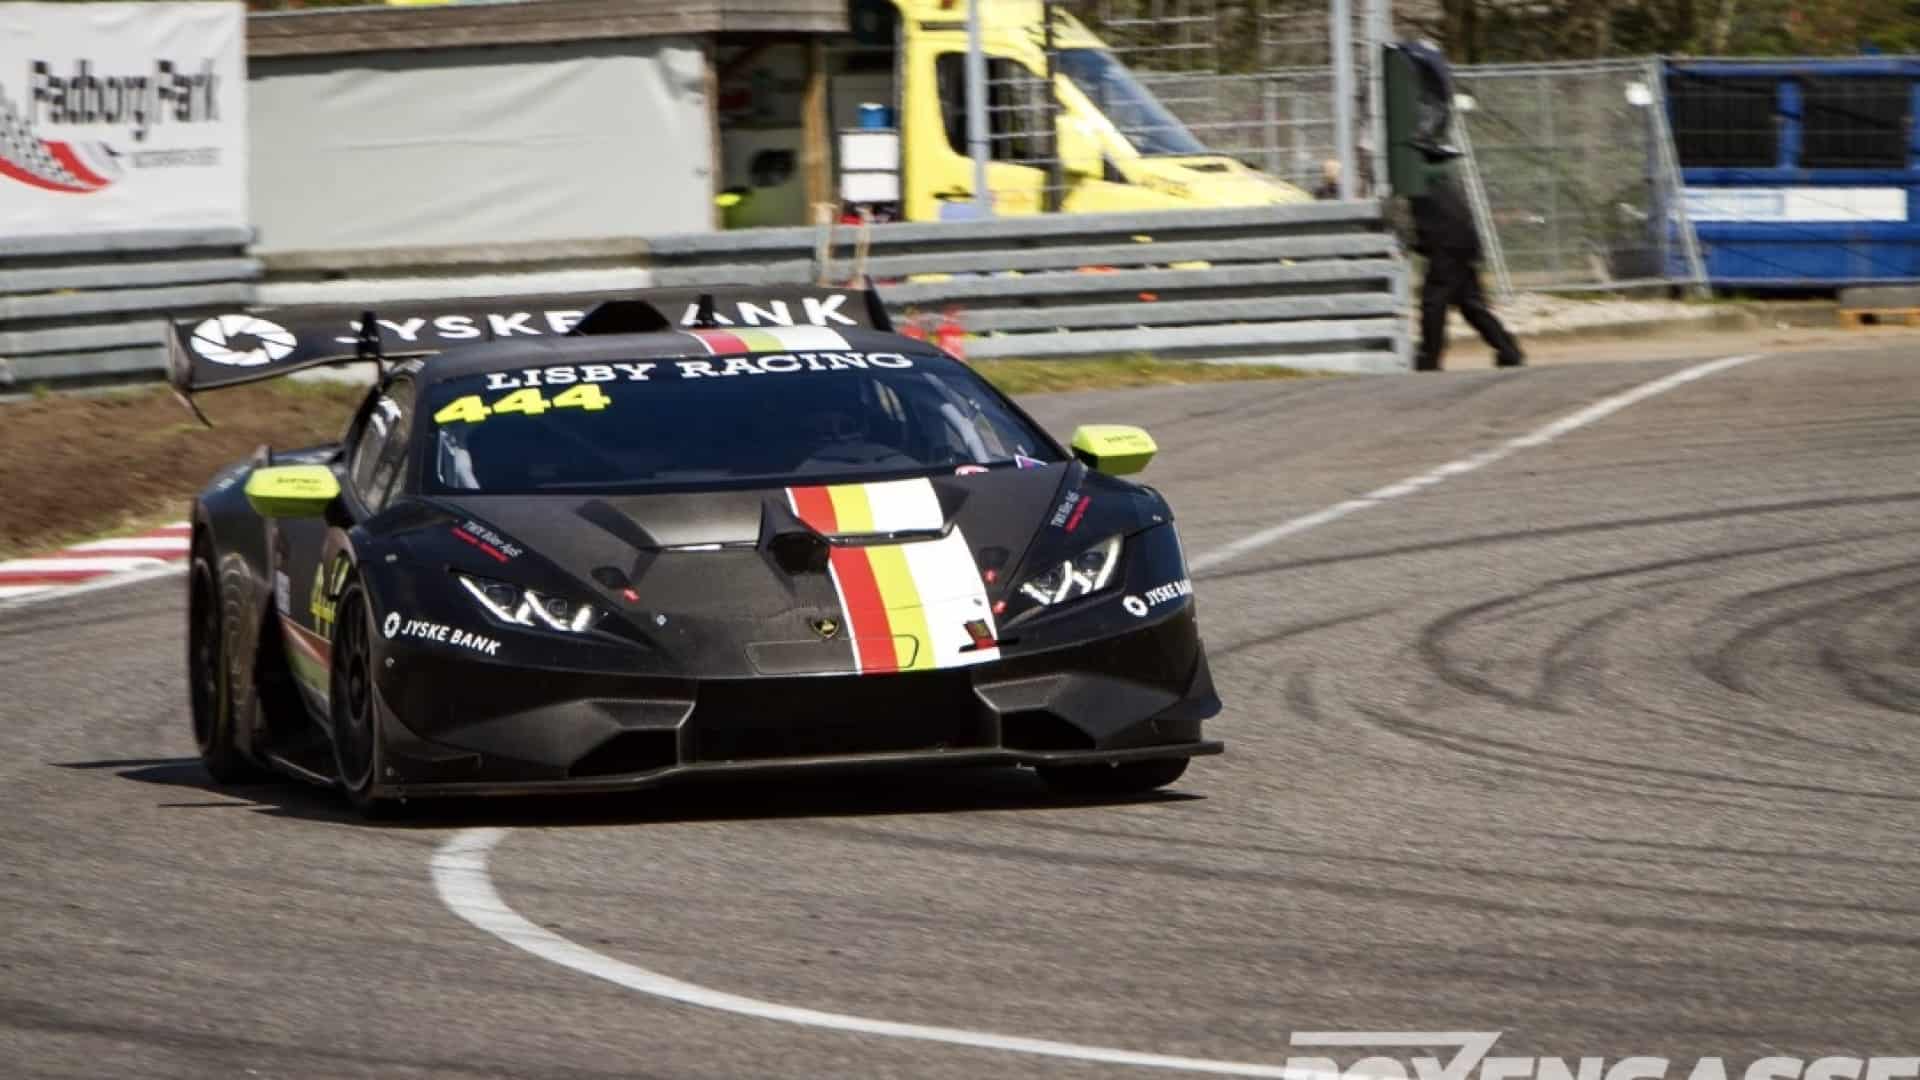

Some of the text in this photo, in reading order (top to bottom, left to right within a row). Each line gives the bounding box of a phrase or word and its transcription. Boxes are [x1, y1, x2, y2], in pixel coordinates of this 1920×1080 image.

[486, 352, 913, 389] LISBY RACING
[433, 383, 612, 424] 444
[401, 620, 501, 655] JYSKE BANK
